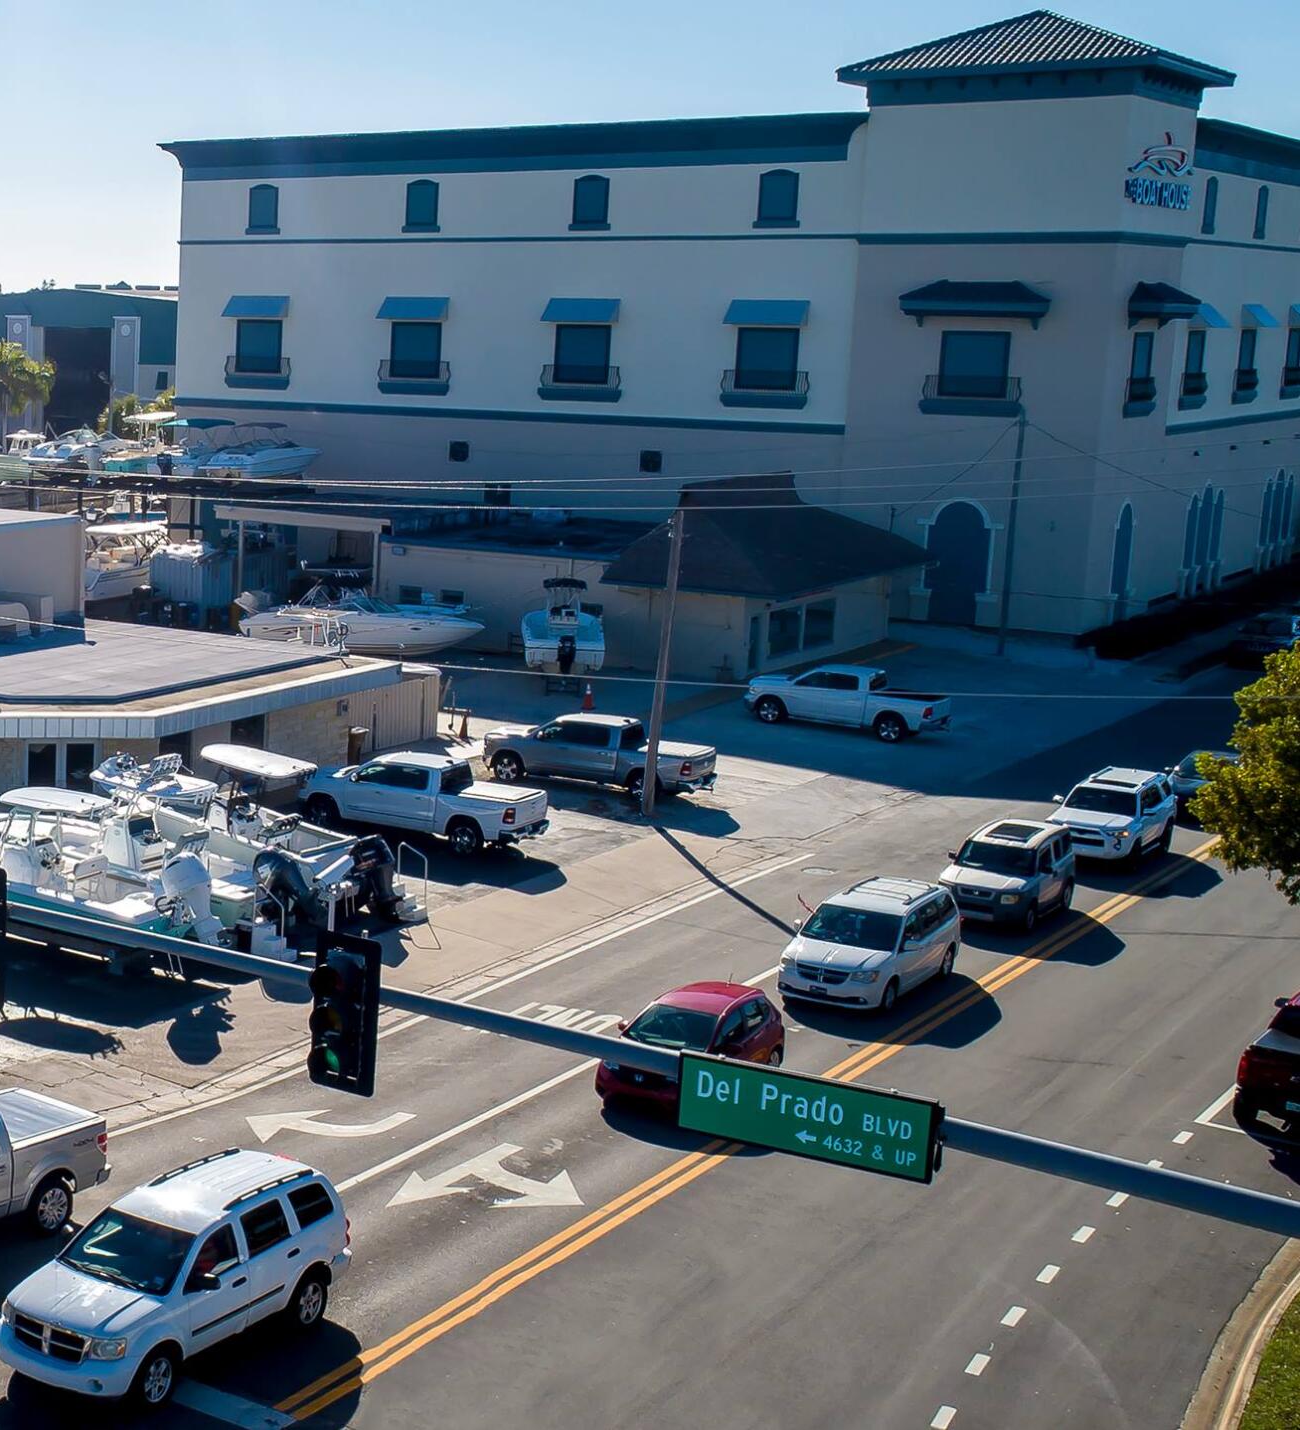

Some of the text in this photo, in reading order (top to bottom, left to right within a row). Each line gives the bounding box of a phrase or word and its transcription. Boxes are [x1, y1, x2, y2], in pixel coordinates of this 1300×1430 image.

[1136, 178, 1161, 207] BOAT
[697, 1070, 912, 1140] Del Prado BLVD
[822, 1135, 916, 1167] 4632 & UP
